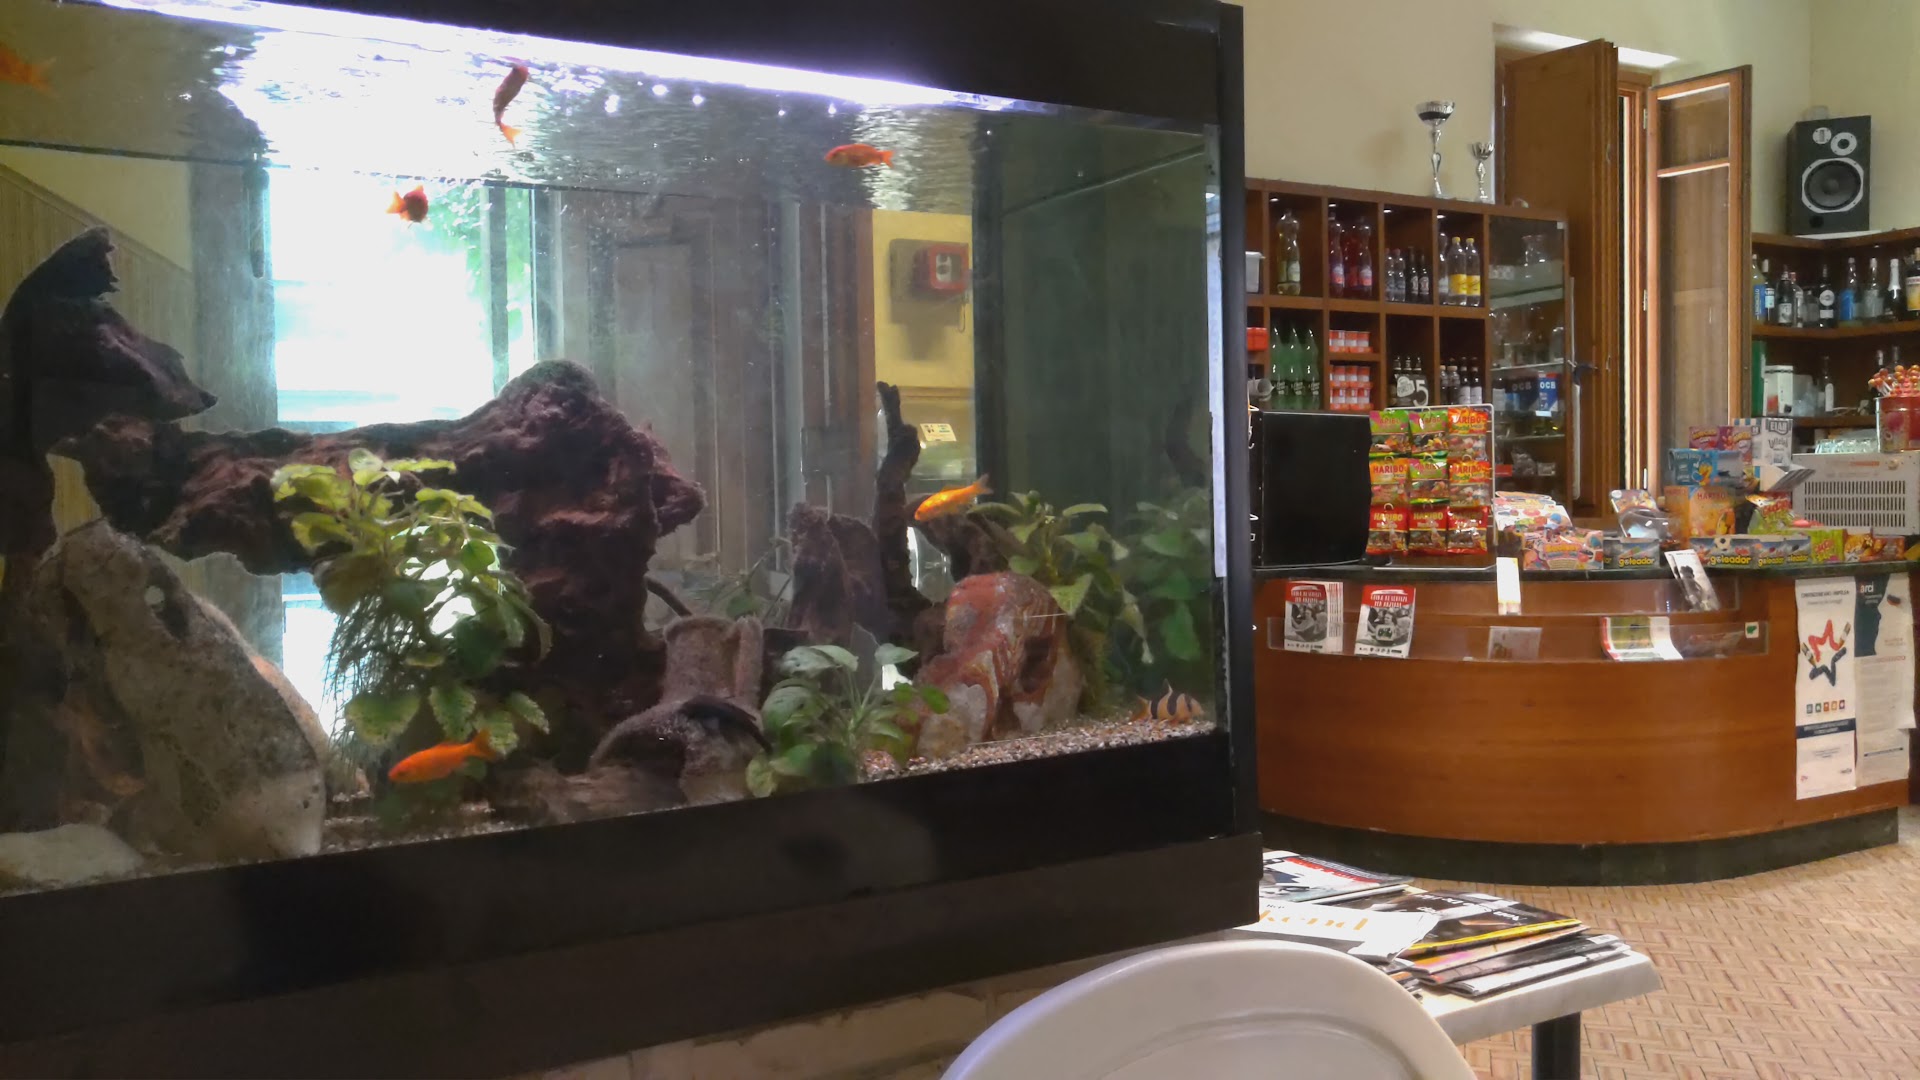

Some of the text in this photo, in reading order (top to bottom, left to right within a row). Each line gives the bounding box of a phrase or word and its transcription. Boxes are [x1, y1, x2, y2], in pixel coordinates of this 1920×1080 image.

[1540, 381, 1556, 389] OCB
[1374, 463, 1404, 474] HARIBO
[1618, 556, 1656, 568] goleador
[1710, 555, 1752, 566] goleador
